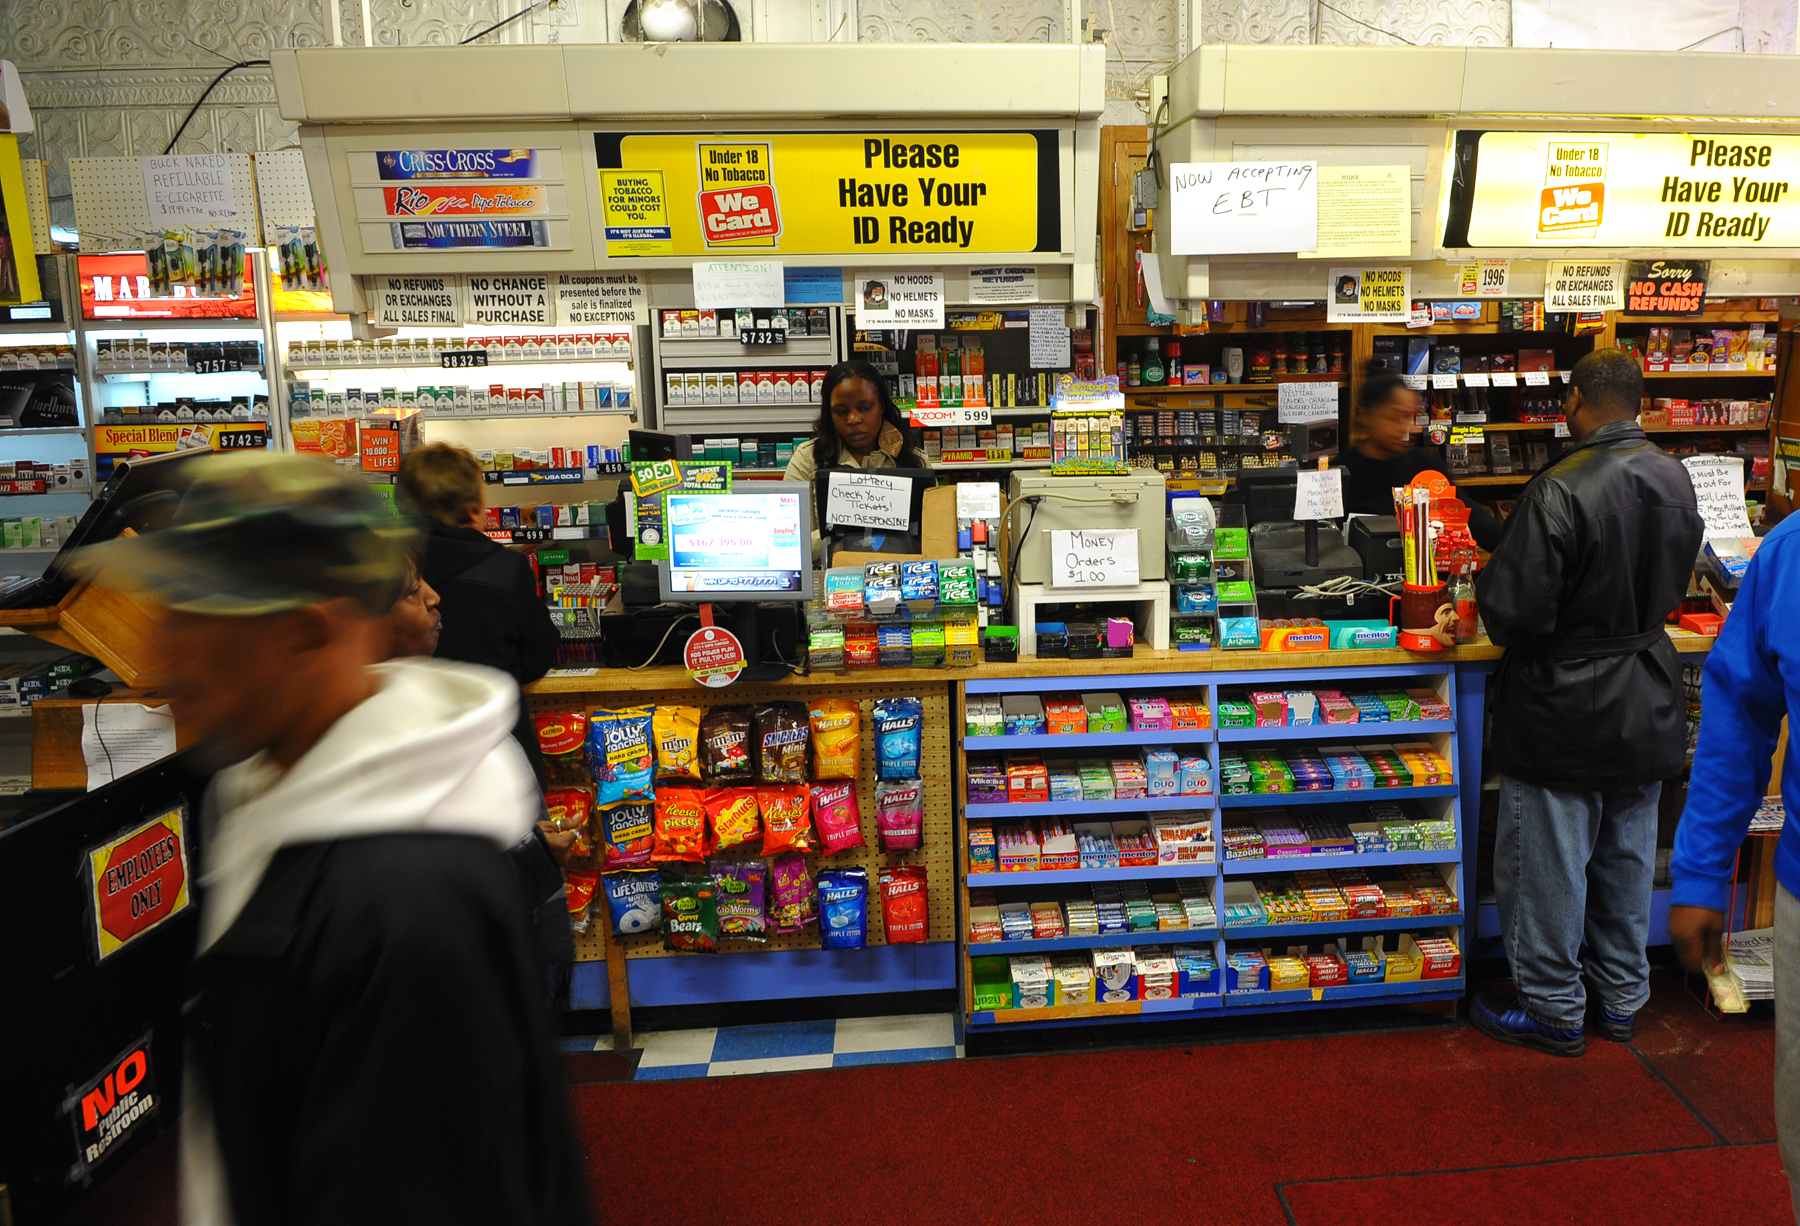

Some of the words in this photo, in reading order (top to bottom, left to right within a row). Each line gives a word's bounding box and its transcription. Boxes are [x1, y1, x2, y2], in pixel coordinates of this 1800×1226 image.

[709, 150, 742, 164] Under
[746, 150, 758, 164] 18
[864, 138, 959, 169] Please
[1556, 148, 1586, 161] Under
[1588, 148, 1599, 160] 18
[1690, 139, 1772, 167] Please
[150, 158, 179, 169] BUCK
[186, 155, 225, 168] NAKED
[400, 150, 496, 172] CRISS-CROSS
[705, 168, 719, 182] No
[721, 167, 765, 182] Tobacco
[1550, 165, 1562, 177] No
[1564, 164, 1602, 177] Tobacco
[154, 170, 224, 187] REFILLABLE
[1176, 169, 1213, 192] NOW
[838, 178, 908, 207] Have
[918, 177, 987, 207] Your
[1661, 176, 1722, 203] Have
[1733, 176, 1788, 203] Your
[155, 191, 225, 203] E-CIGARETTE
[395, 187, 429, 215] Rio
[472, 194, 494, 211] Pipe
[496, 195, 535, 208] Tobacco
[714, 192, 759, 213] We
[1213, 187, 1286, 215] EBT
[1552, 188, 1592, 207] We
[610, 204, 638, 212] COULD
[1542, 203, 1599, 225] Card
[707, 208, 772, 233] Card
[1665, 212, 1690, 236] ID
[1696, 212, 1771, 241] Ready
[426, 222, 488, 239] SOUTHERN
[489, 221, 531, 239] STEEL
[853, 216, 879, 244] ID
[889, 215, 974, 248] Ready
[708, 263, 773, 273] ATTENTION!
[1563, 266, 1574, 277] NO
[1576, 266, 1611, 277] REFUNDS
[1648, 261, 1693, 283] Sorry
[559, 274, 569, 285] All
[571, 276, 604, 286] coupons
[606, 274, 626, 284] must
[627, 274, 638, 283] be
[894, 275, 905, 285] NO
[907, 275, 933, 285] HOODS
[1365, 271, 1376, 282] NO
[1378, 271, 1402, 282] HOODS
[1482, 269, 1505, 286] 1996
[388, 278, 401, 291] NO
[404, 278, 444, 291] REFUNDS
[471, 278, 489, 291] NO
[492, 278, 546, 291] CHANGE
[1555, 280, 1567, 291] OR
[1568, 280, 1614, 291] EXCHANGES
[1629, 281, 1656, 296] NO
[1660, 281, 1703, 296] CASH
[560, 286, 599, 300] presented
[601, 286, 627, 297] before
[629, 286, 641, 296] the
[891, 292, 902, 301] NO
[903, 291, 938, 301] HELMETS
[1361, 286, 1371, 297] NO
[1372, 286, 1405, 297] HELMETS
[385, 294, 398, 306] OR
[400, 294, 452, 307] EXCHANGES
[474, 294, 532, 307] WITHOUT
[537, 294, 546, 306] A
[571, 300, 588, 310] sale
[590, 299, 597, 309] is
[599, 299, 632, 309] finalized
[1364, 300, 1374, 312] NO
[1376, 300, 1401, 311] MASKS
[1552, 295, 1566, 306] ALL
[1567, 295, 1591, 306] SALES
[1593, 295, 1616, 306] FINAL
[1629, 297, 1700, 311] REFUNDS
[383, 310, 399, 322] ALL
[402, 310, 429, 323] SALES
[431, 310, 455, 323] FINAL
[477, 310, 544, 322] PURCHASE
[570, 312, 581, 322] NO
[584, 311, 635, 322] EXCEPTIONS
[895, 309, 906, 318] NO
[907, 309, 934, 318] MASKS
[921, 412, 952, 420] ZOOM
[106, 428, 148, 445] Special
[149, 428, 180, 443] Blend
[372, 438, 388, 446] WIN
[374, 457, 397, 467] LIFE!
[942, 451, 973, 461] PYRAMID
[637, 470, 654, 482] 50
[656, 464, 672, 476] 50
[700, 466, 720, 474] TICKET
[850, 473, 893, 491] Lottery
[831, 487, 863, 500] Check
[865, 490, 886, 502] Your
[851, 500, 893, 511] Tickets!
[831, 513, 852, 523] NOT
[854, 514, 907, 527] RESPONSIBLE
[1066, 553, 1116, 569] Orders
[870, 563, 896, 574] ICE
[944, 566, 968, 578] ICE
[1356, 632, 1391, 640] mentos
[53, 664, 72, 673] KOOL
[818, 717, 850, 729] HALLS
[604, 724, 641, 744] JOLLY
[764, 727, 809, 747] SNICKERS
[607, 737, 646, 753] rancher
[782, 743, 806, 754] Minis
[609, 753, 626, 761] HARD
[627, 748, 646, 758] CANDY
[1186, 779, 1207, 787] DUO
[665, 803, 700, 817] Reese's
[718, 796, 756, 834] Starburst
[663, 818, 700, 831] pieces
[1121, 850, 1156, 858] mentos
[1187, 845, 1214, 853] LEAGUE
[1225, 846, 1264, 859] Bazooka
[1082, 852, 1117, 861] mentos
[1178, 852, 1198, 860] CHEW
[107, 835, 175, 897] EMPLOYEES
[612, 886, 631, 898] LIFE
[631, 880, 659, 896] SAVERS
[888, 883, 919, 895] HALLS
[130, 878, 162, 919] ONLY
[670, 919, 702, 932] Bears
[1355, 967, 1378, 975] HALLS
[974, 997, 1001, 1006] UP2U
[82, 1049, 147, 1132] NO
[98, 1090, 139, 1137] Public
[86, 1093, 154, 1163] Restroom
